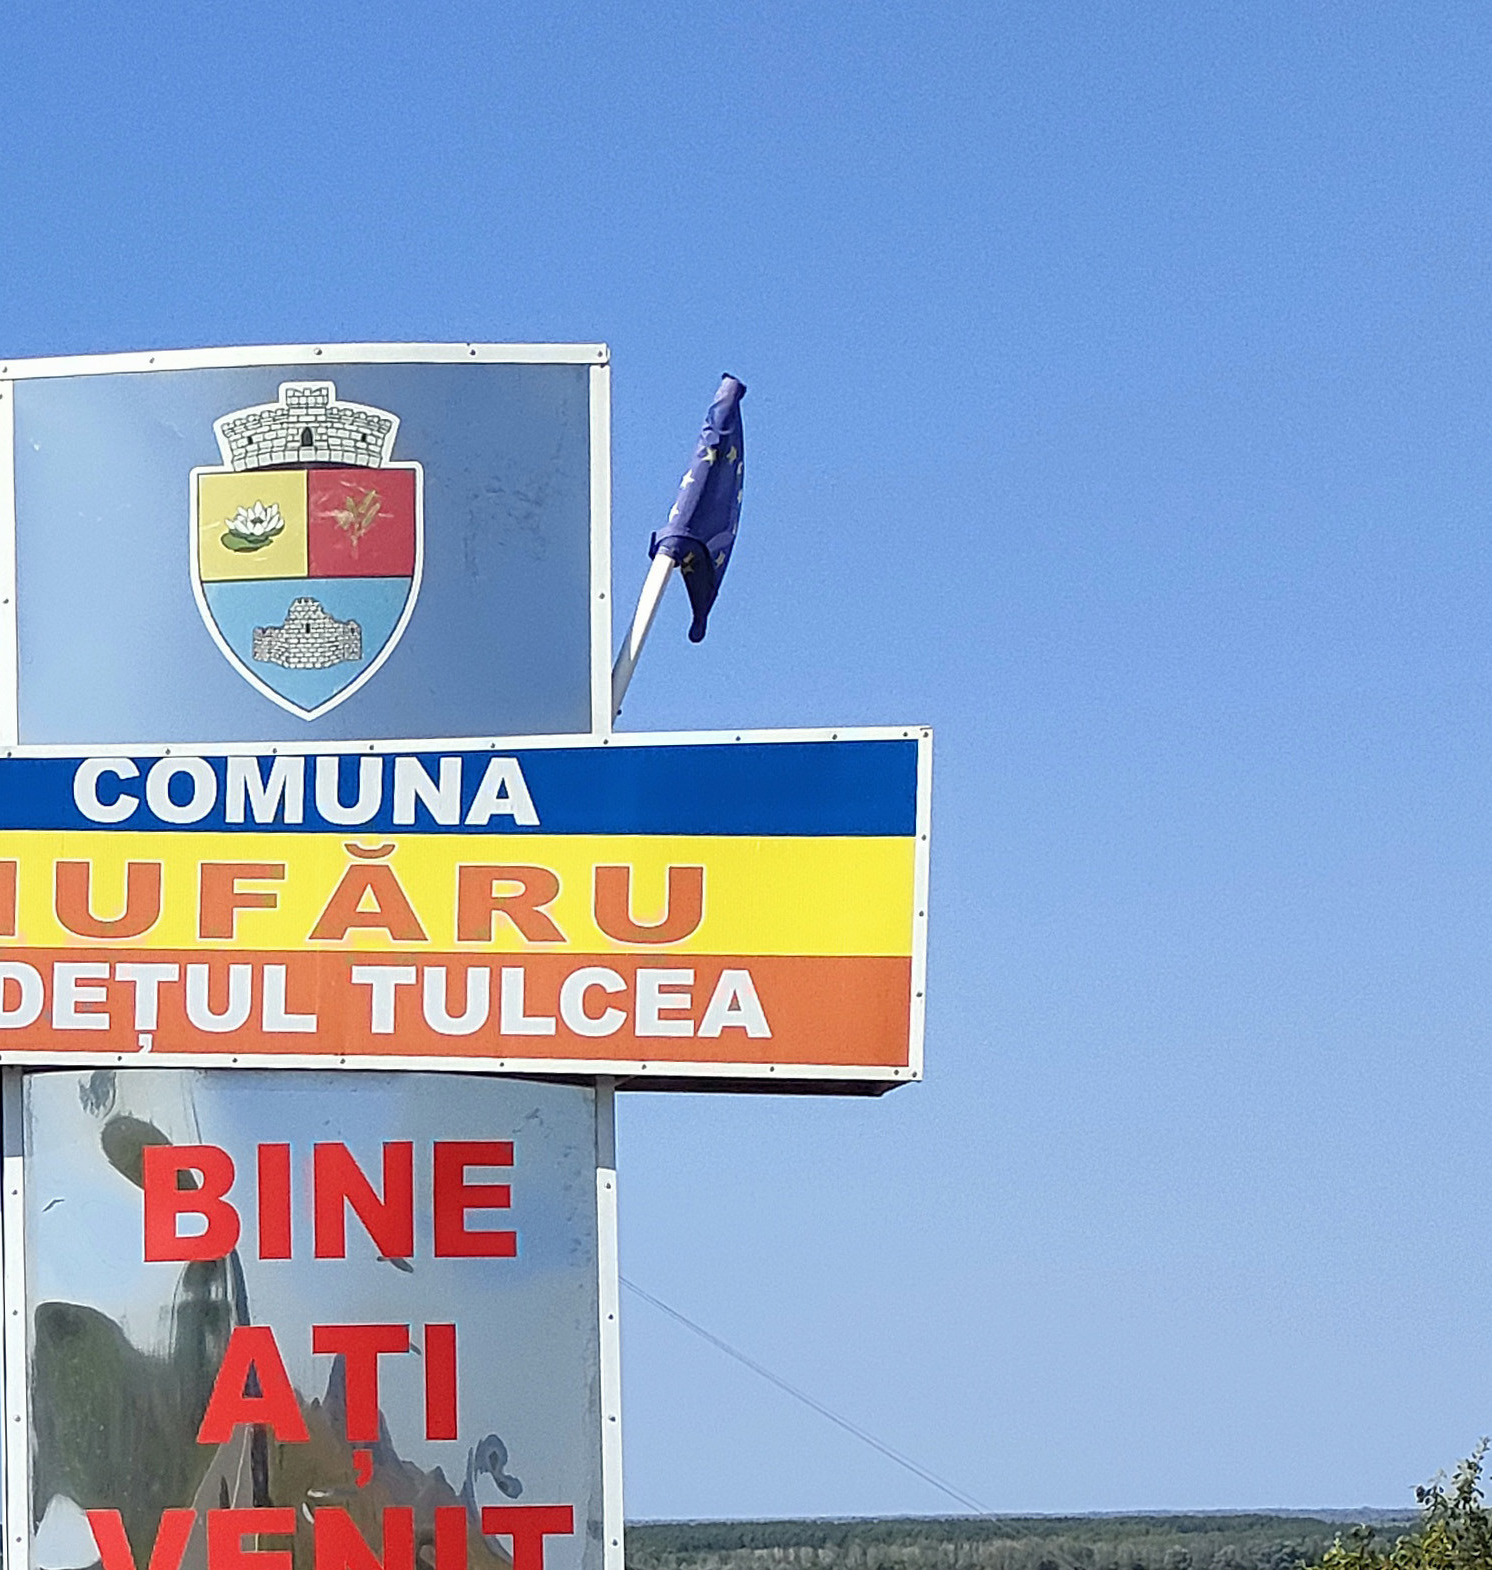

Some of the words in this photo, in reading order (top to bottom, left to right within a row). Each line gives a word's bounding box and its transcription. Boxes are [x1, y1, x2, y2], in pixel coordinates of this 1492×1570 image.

[73, 755, 540, 826] COMUNA
[352, 965, 773, 1040] TULCEA
[143, 1140, 517, 1262] BINE
